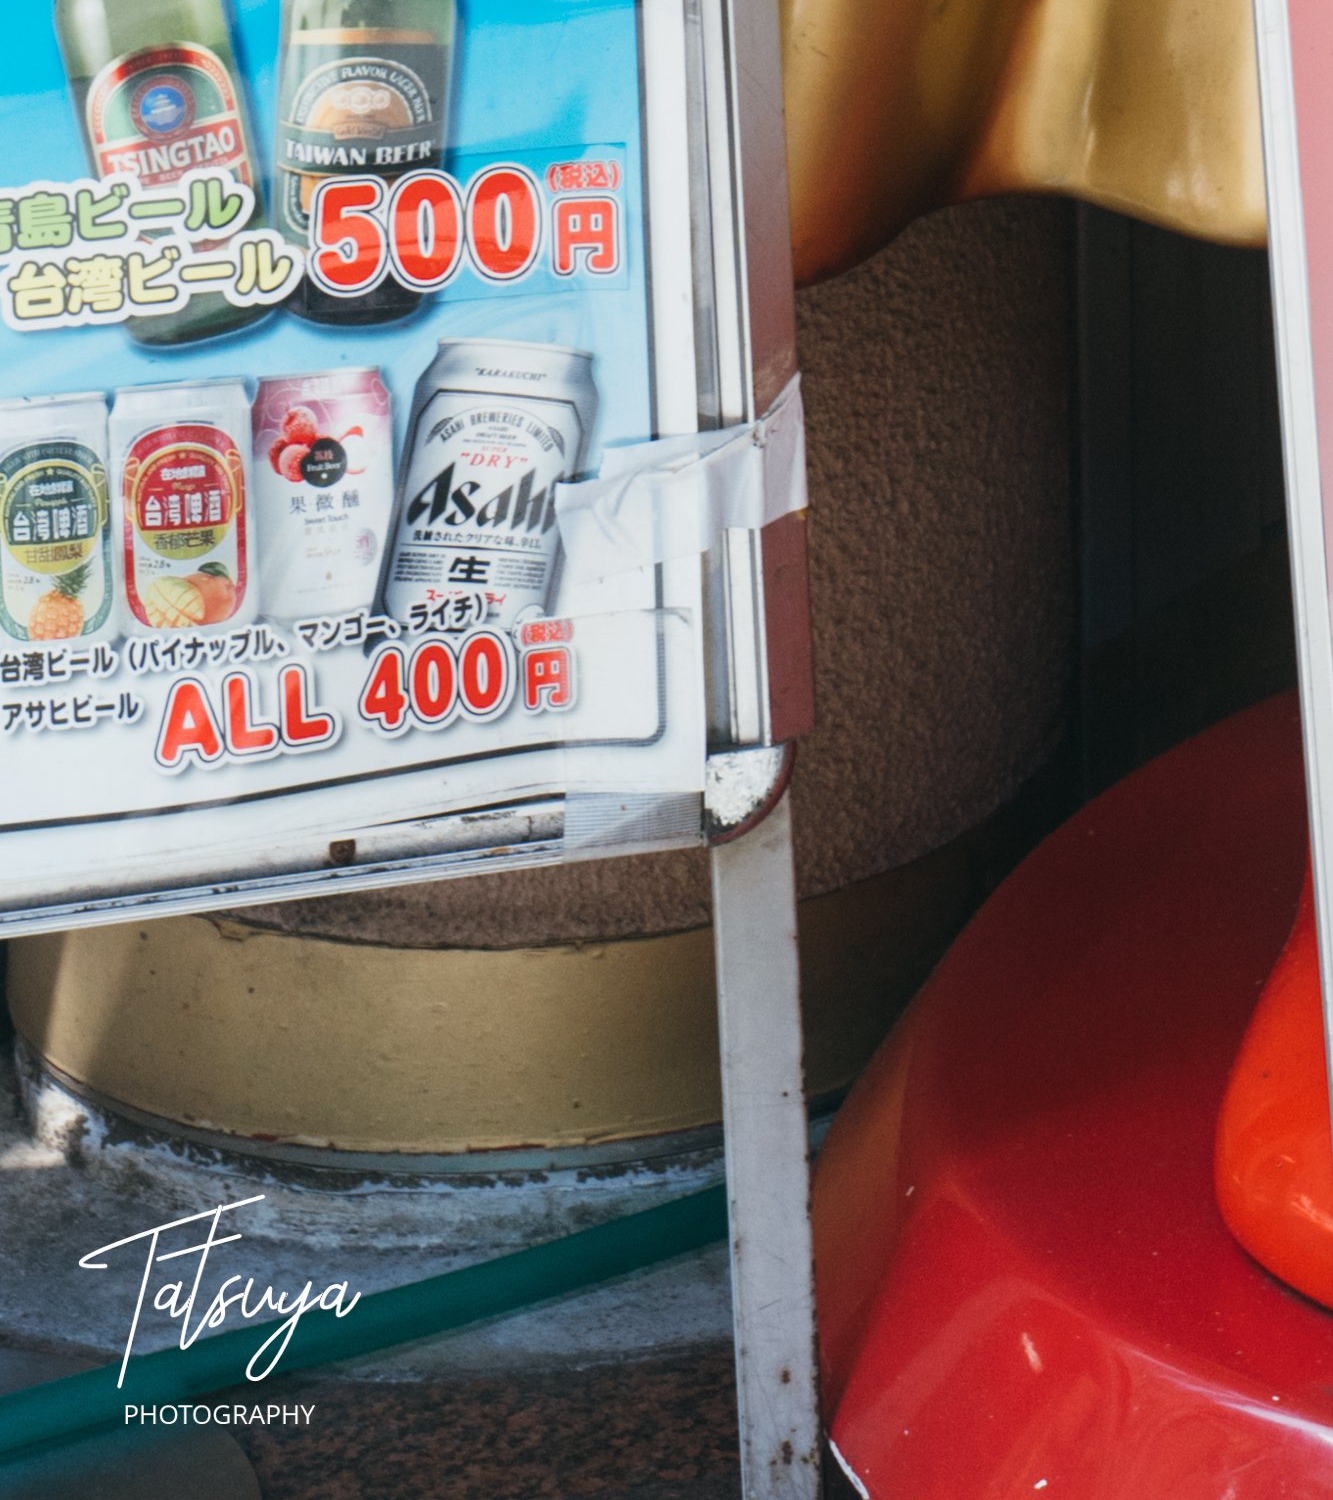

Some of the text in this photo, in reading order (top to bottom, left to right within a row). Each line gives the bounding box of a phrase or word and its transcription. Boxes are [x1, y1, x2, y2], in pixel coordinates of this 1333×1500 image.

[105, 126, 238, 176] TSINGTAO
[286, 139, 433, 167] TAIWAN BEER
[547, 160, 621, 192] (税込)
[0, 177, 241, 251] 島ビール
[313, 167, 621, 290] 500円
[9, 243, 293, 320] 台湾ビール
[440, 419, 464, 442] ASAHI
[470, 411, 525, 428] BREWERIES
[448, 556, 491, 584] 生
[3, 693, 139, 733] アサヒビール
[156, 634, 572, 766] ALL 400円
